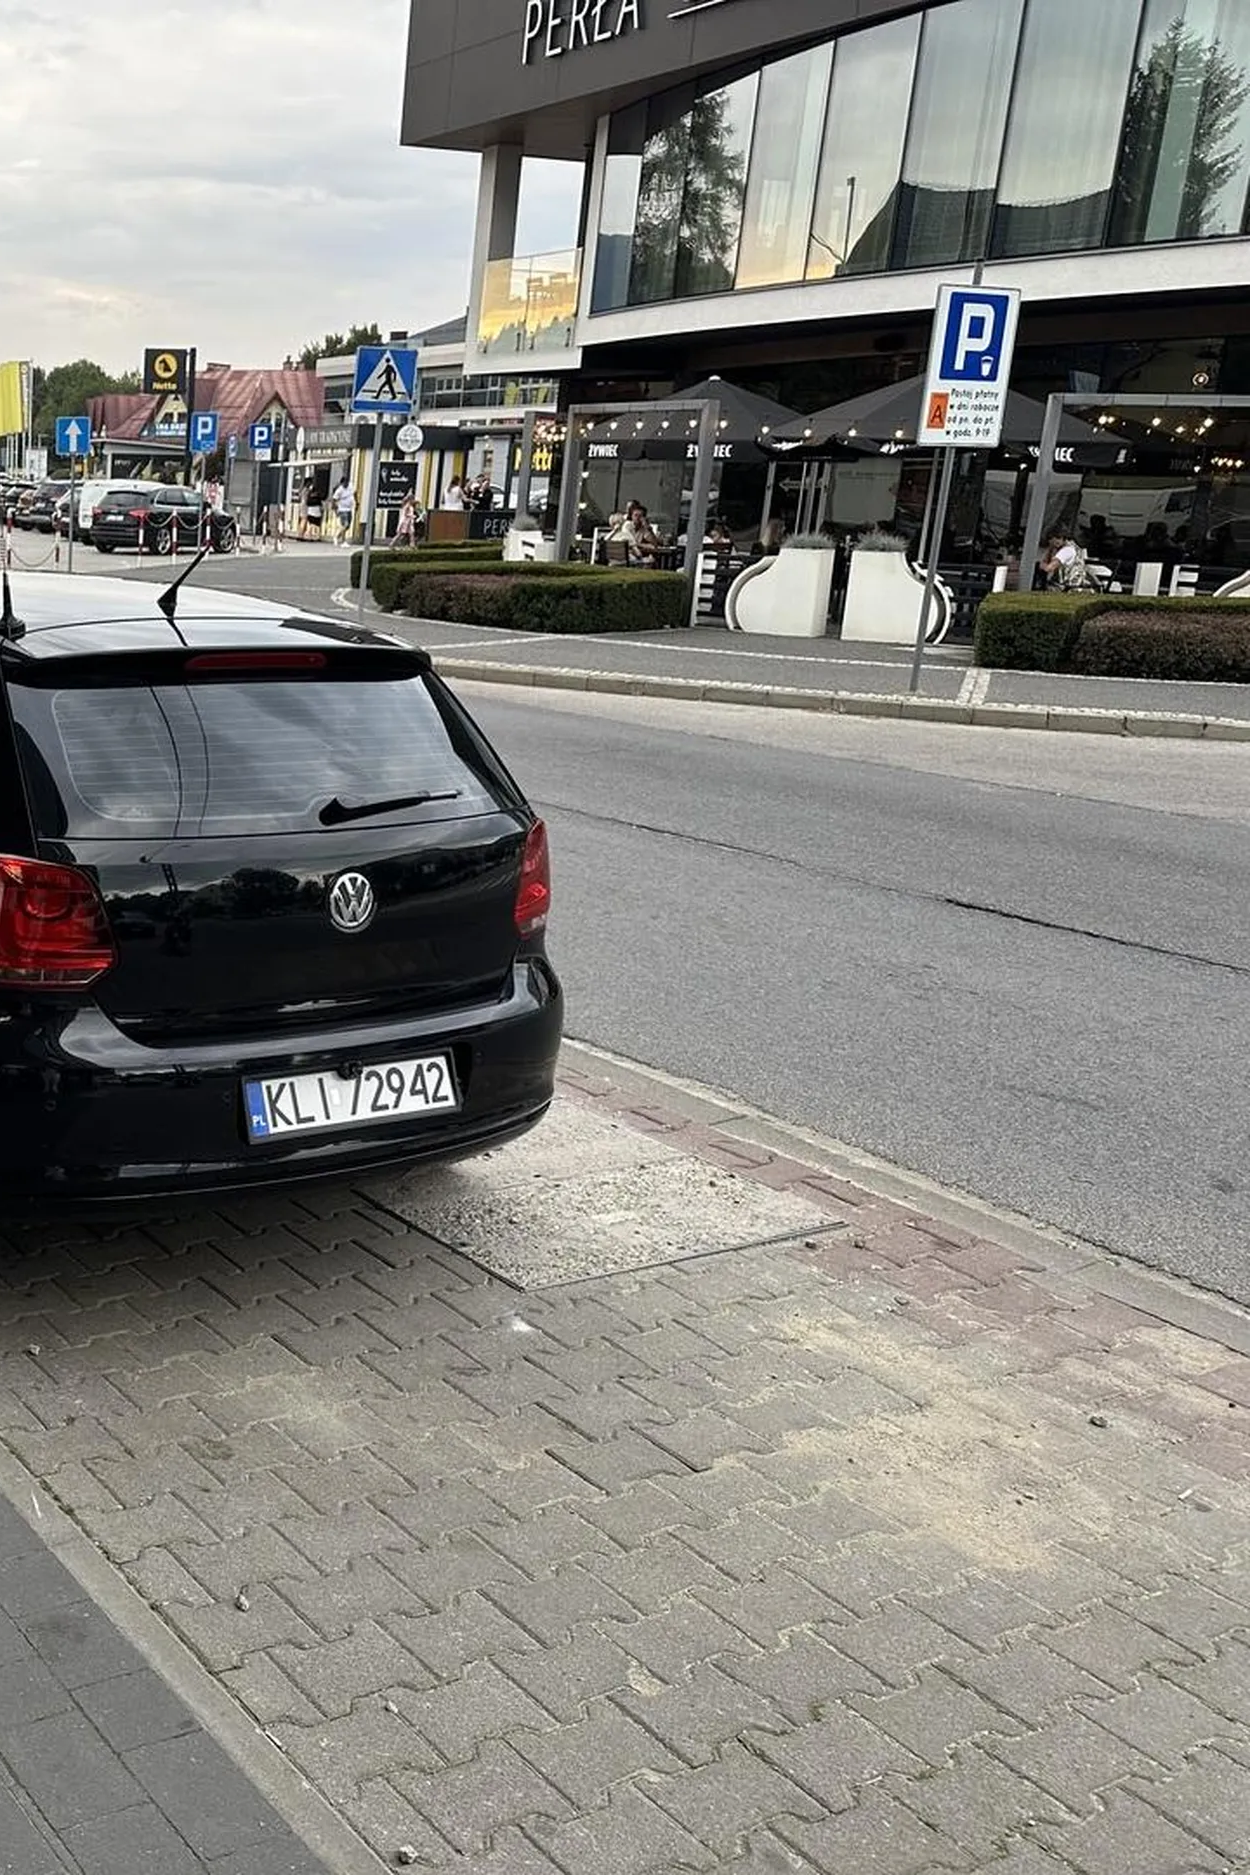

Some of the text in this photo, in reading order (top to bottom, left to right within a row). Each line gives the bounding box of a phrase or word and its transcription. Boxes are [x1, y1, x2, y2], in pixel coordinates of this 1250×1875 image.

[954, 302, 996, 371] P
[930, 405, 945, 423] A
[197, 416, 214, 440] P
[254, 426, 268, 446] P
[588, 443, 619, 458] ŻYWIEC
[265, 1061, 450, 1128] KLI 72942
[252, 1114, 266, 1127] PL
